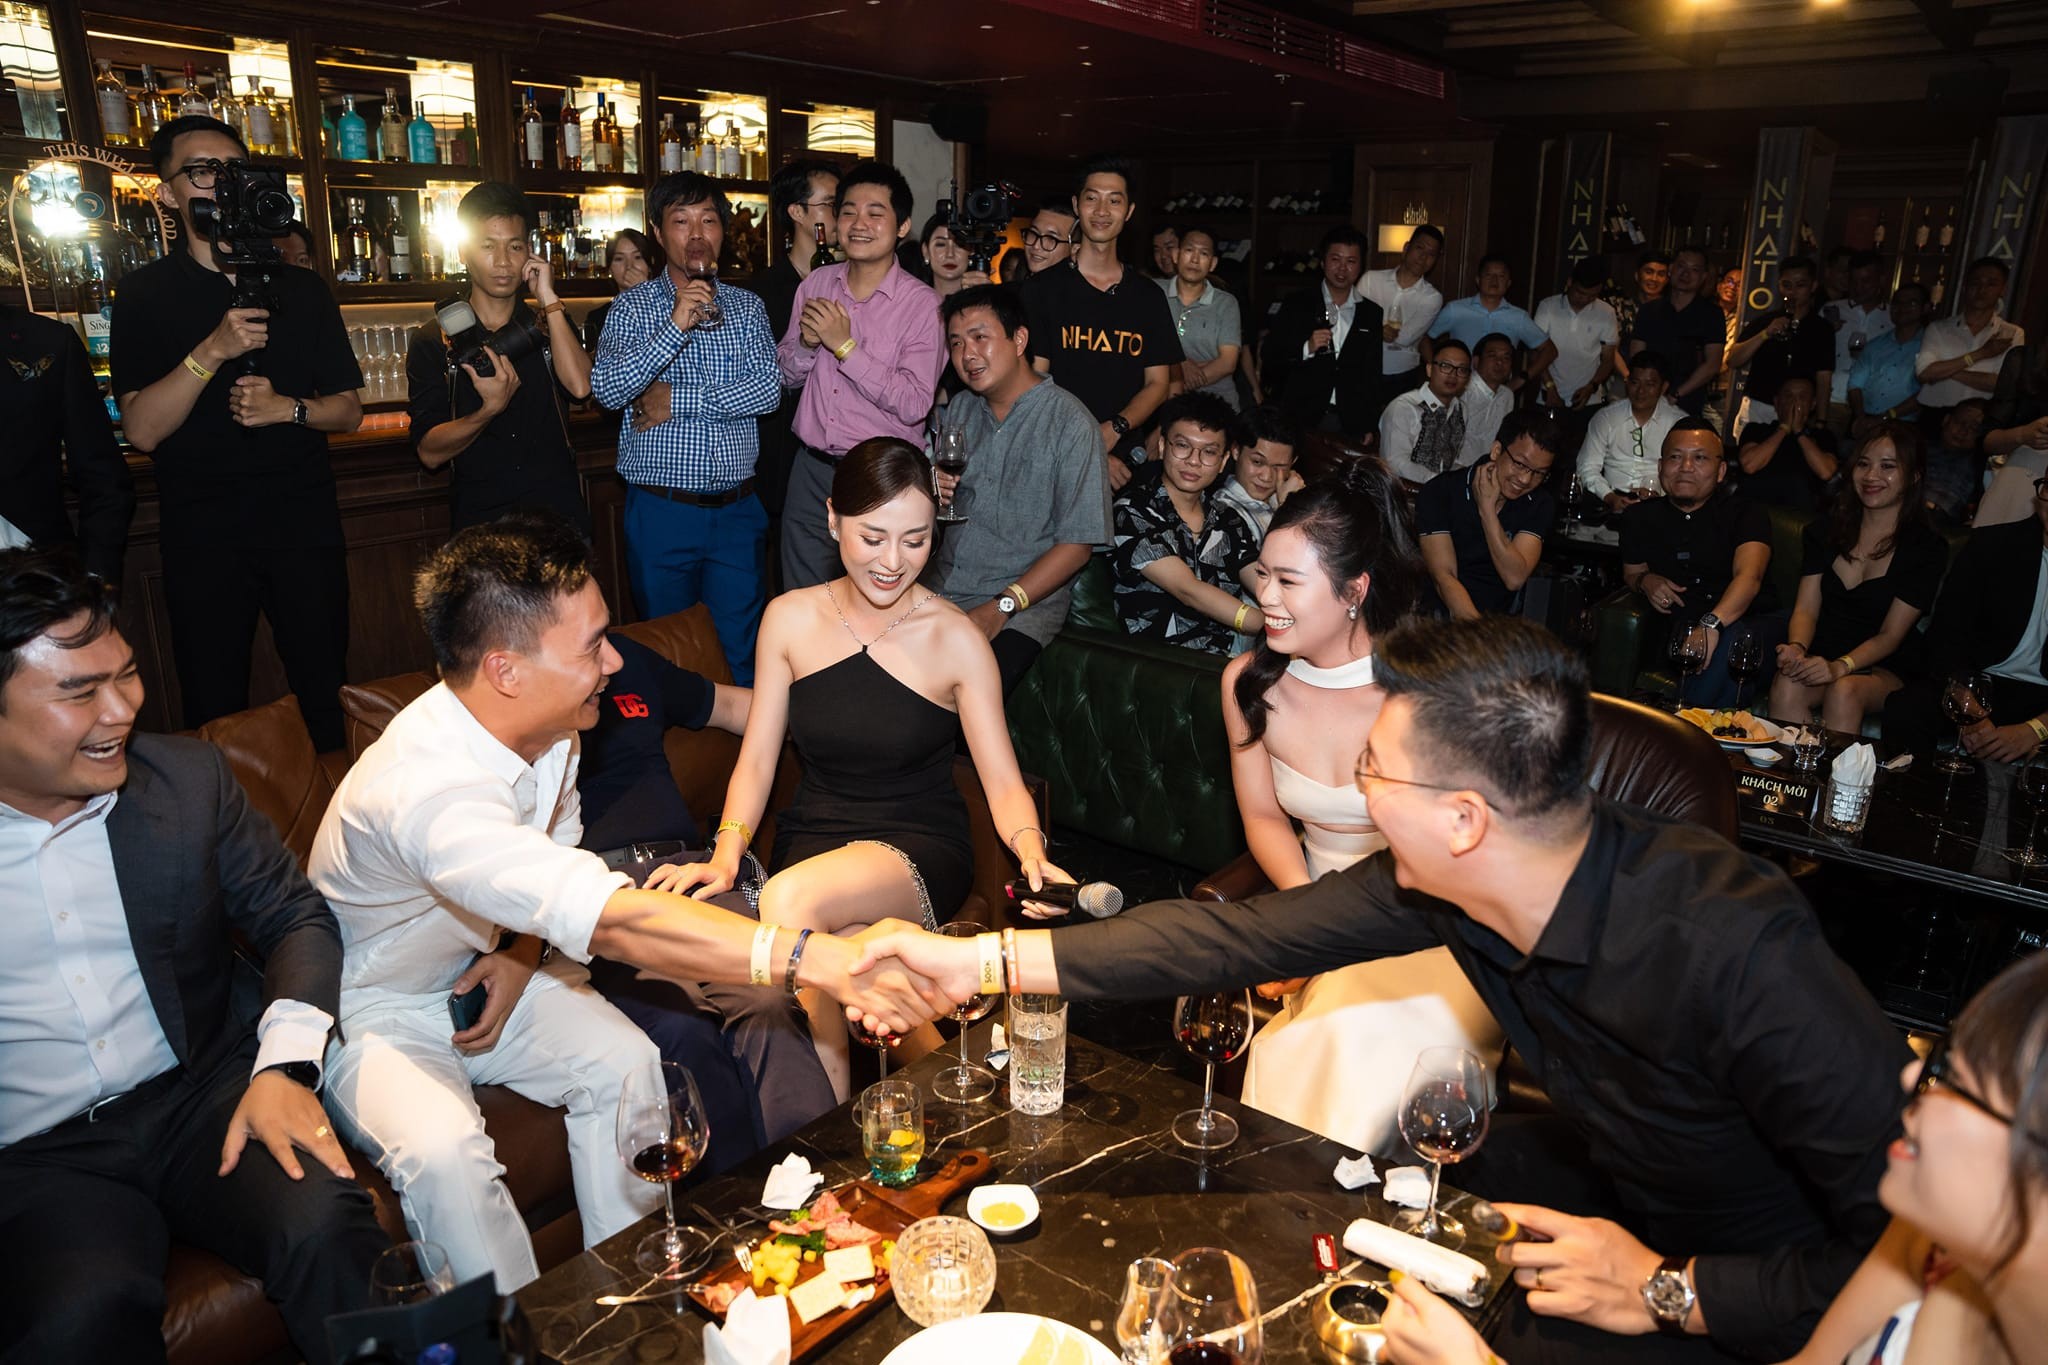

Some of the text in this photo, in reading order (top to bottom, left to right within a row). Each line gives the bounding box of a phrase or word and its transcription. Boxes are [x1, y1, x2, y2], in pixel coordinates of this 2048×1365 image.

[43, 143, 89, 158] THIS
[1567, 177, 1595, 267] NHAT
[1986, 172, 2032, 262] NHA
[1747, 176, 1789, 310] NHATO
[89, 320, 111, 331] SING
[1062, 325, 1143, 357] NHATO
[1741, 775, 1782, 792] KHÁCH
[1763, 794, 1779, 806] 02
